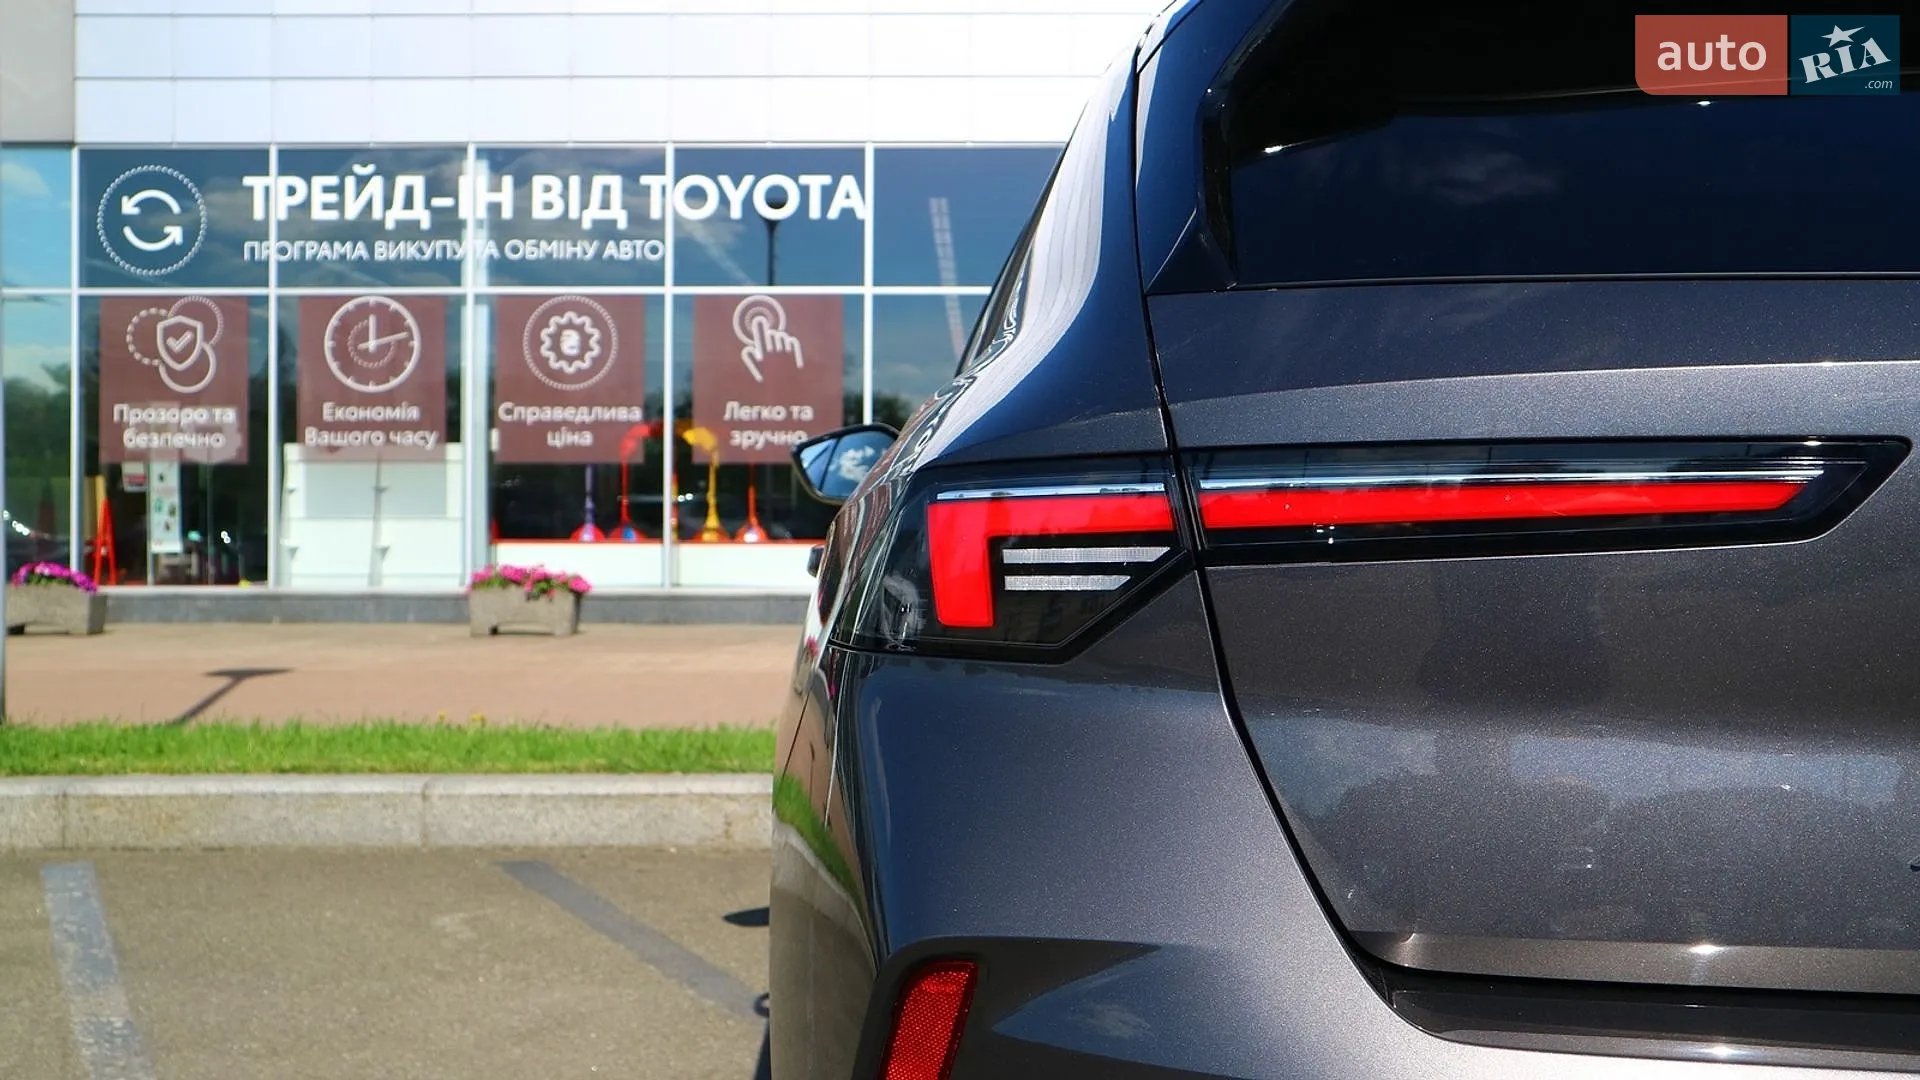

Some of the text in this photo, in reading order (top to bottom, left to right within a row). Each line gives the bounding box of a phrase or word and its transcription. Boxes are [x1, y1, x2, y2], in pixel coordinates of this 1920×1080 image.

[242, 163, 866, 231] ТРЕЙД-ІН ВІД TOYOTA
[243, 240, 369, 262] ПРОГРАМА
[374, 240, 468, 261] ВИКУПУ
[504, 239, 601, 261] ОБМІНУ
[602, 239, 665, 261] АВТО
[113, 403, 238, 427] Прозоро та
[322, 401, 421, 423] Економія
[498, 402, 643, 425] Справедлива
[723, 400, 814, 422] Легко та
[122, 427, 226, 449] безпечно
[304, 426, 440, 450] Вашого часу
[546, 427, 594, 448] ціна
[729, 429, 808, 450] зручно
